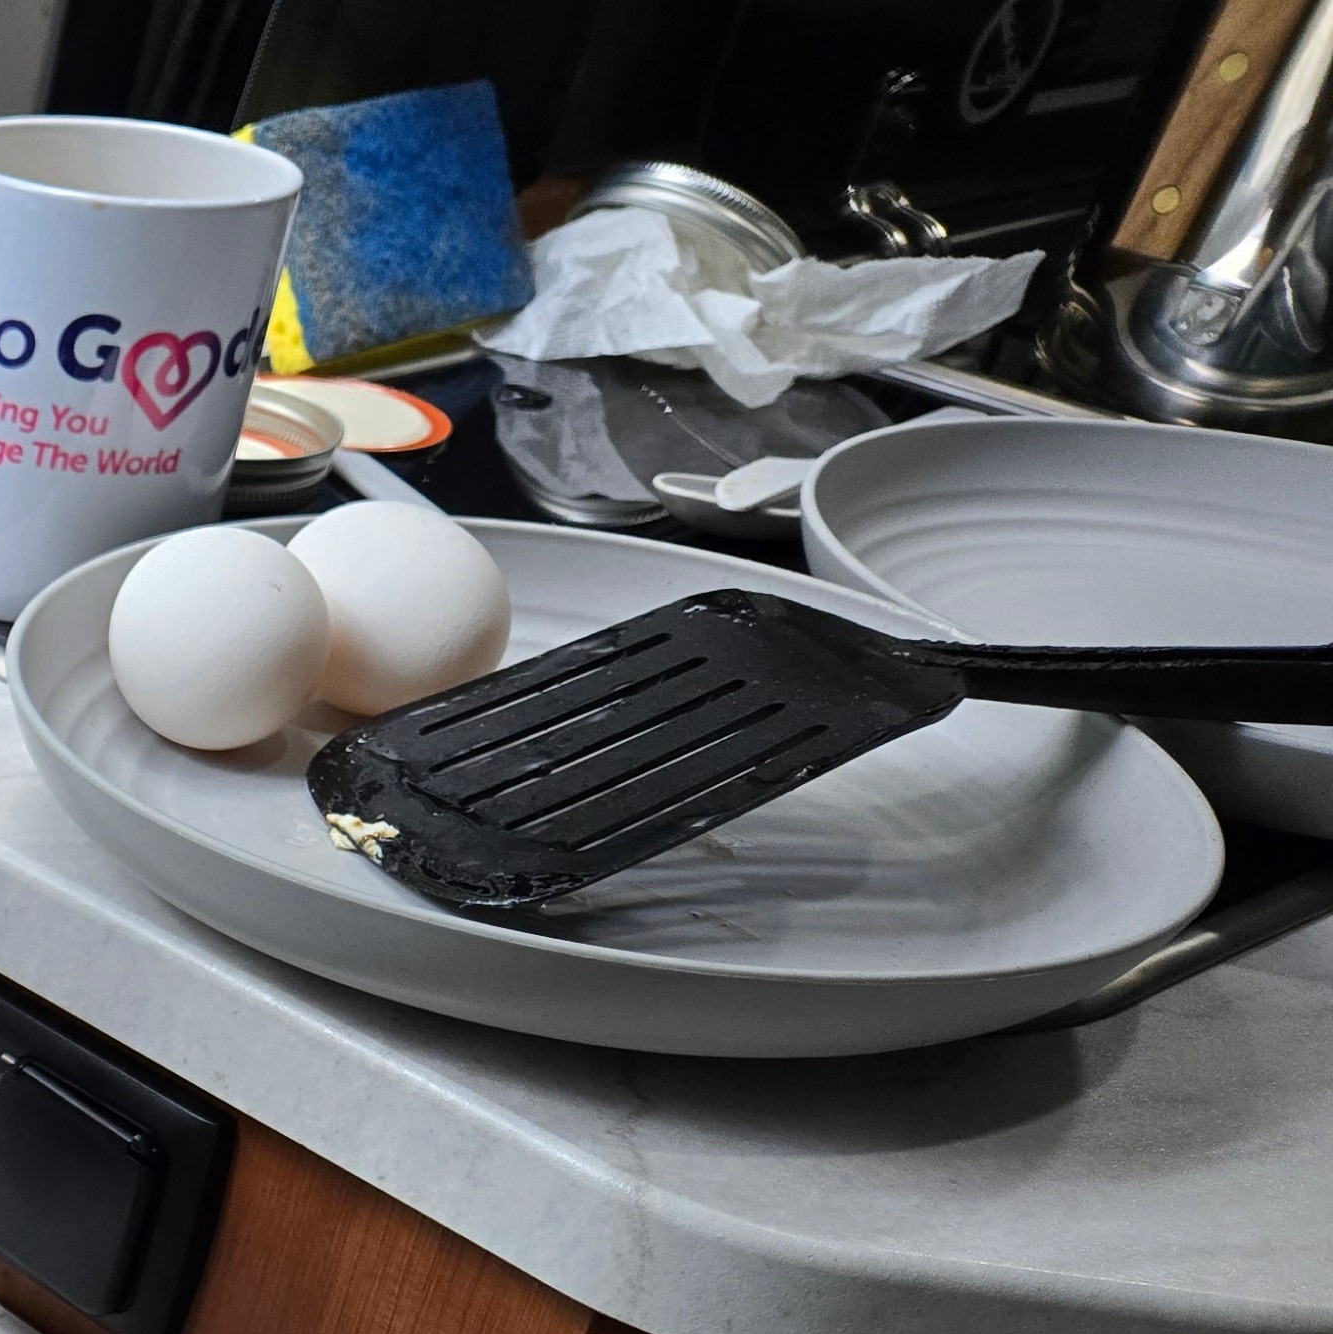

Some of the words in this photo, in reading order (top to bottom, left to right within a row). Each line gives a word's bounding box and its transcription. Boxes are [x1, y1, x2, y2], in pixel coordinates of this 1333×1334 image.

[52, 404, 109, 436] You
[33, 440, 88, 473] The
[97, 448, 181, 475] World
